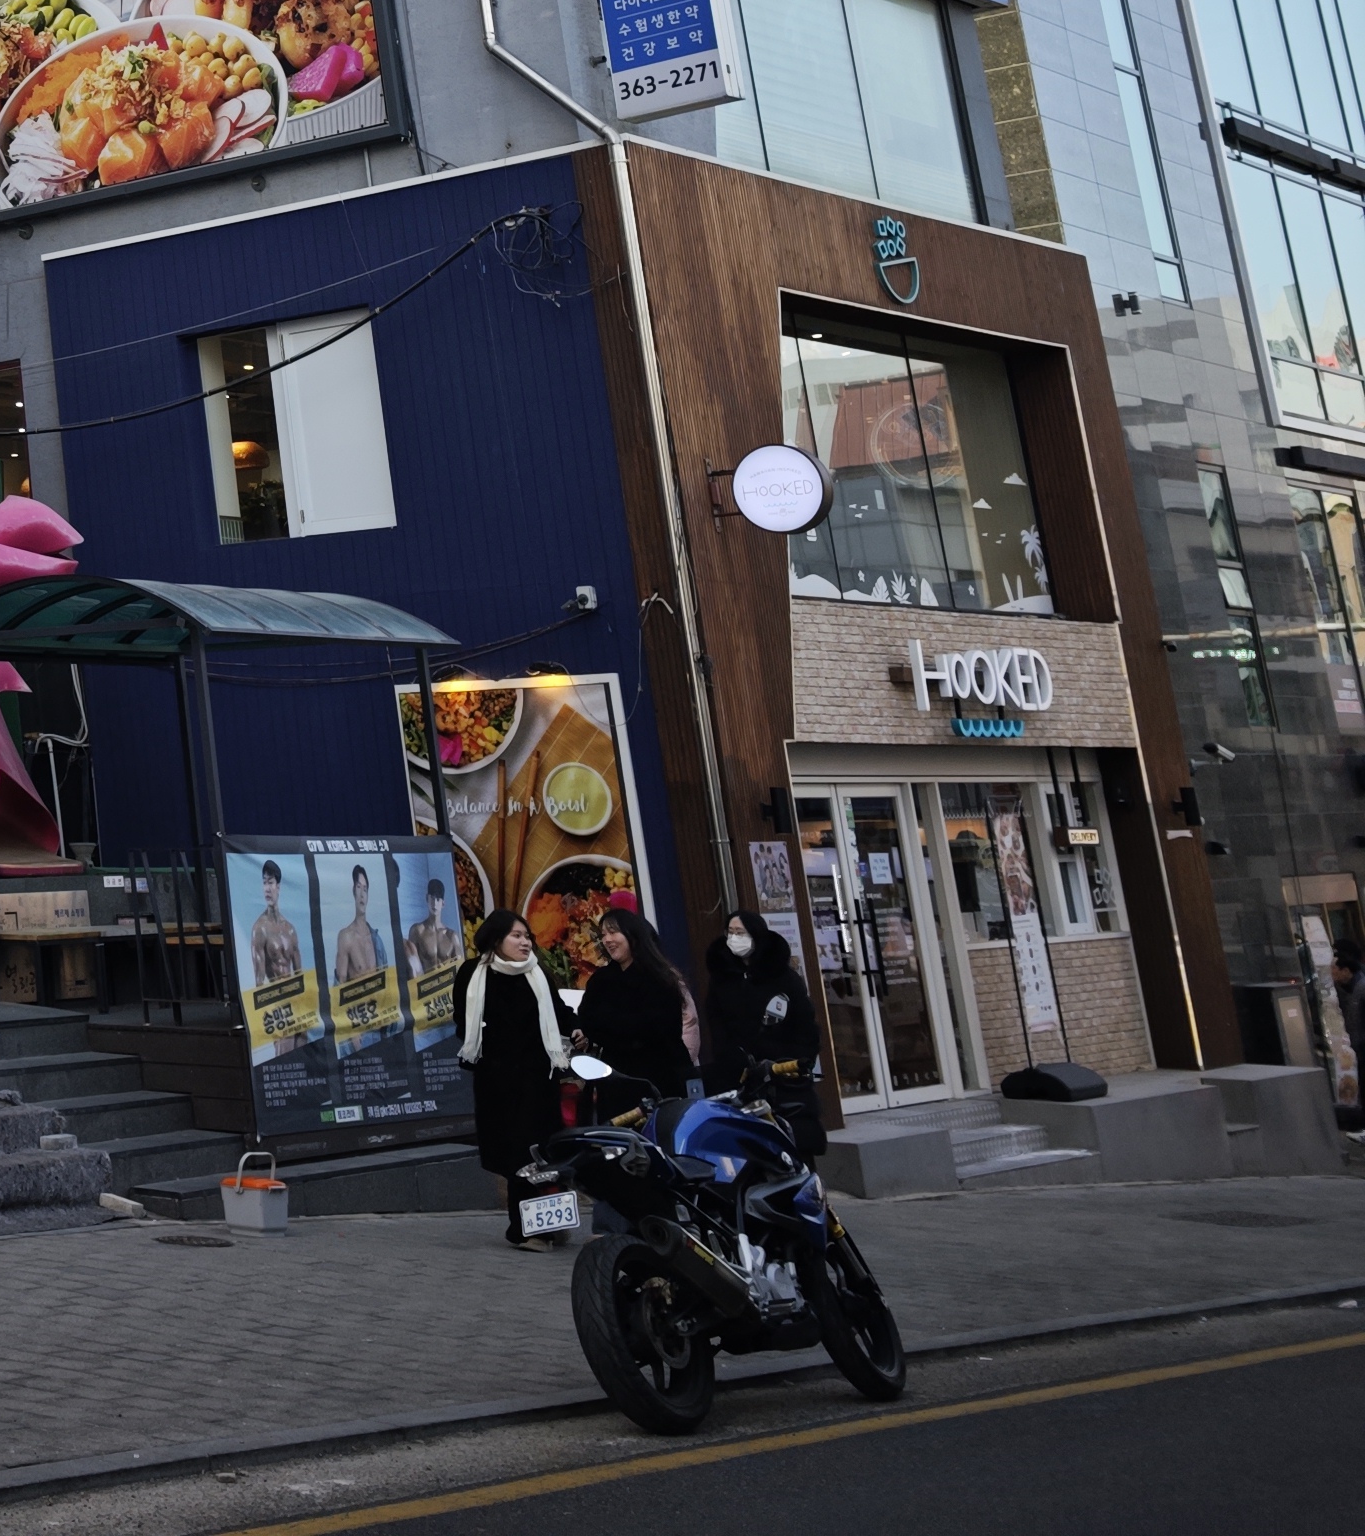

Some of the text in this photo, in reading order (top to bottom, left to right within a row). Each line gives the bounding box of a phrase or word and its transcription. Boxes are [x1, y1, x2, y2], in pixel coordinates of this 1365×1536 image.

[618, 60, 719, 100] 363-2271
[742, 479, 814, 501] HOOKED
[908, 638, 1053, 712] HOOKED
[445, 791, 589, 818] Balance Bowl
[1071, 832, 1097, 841] DELIVERY
[536, 1207, 573, 1227] 5293
